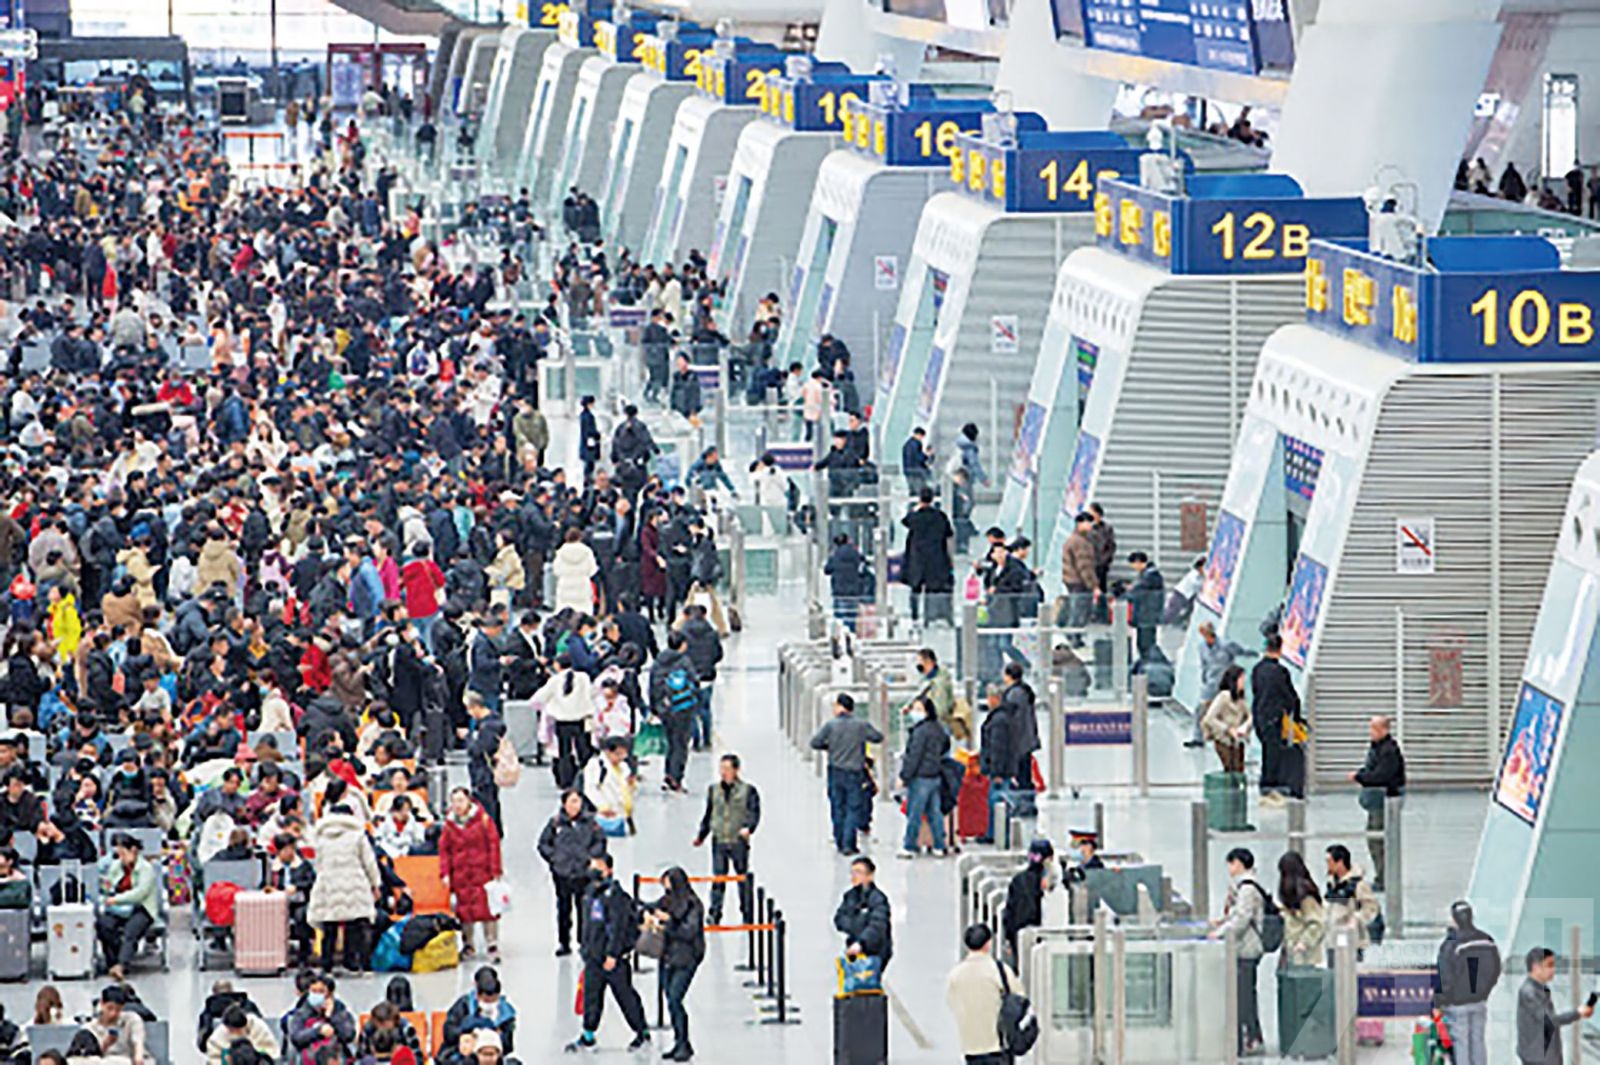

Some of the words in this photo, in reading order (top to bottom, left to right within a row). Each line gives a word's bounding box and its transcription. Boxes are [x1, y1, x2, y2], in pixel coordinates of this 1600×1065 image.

[914, 121, 982, 157] 16
[1040, 160, 1120, 201] 14
[1211, 211, 1310, 260] 12B
[1471, 289, 1594, 347] 10B
